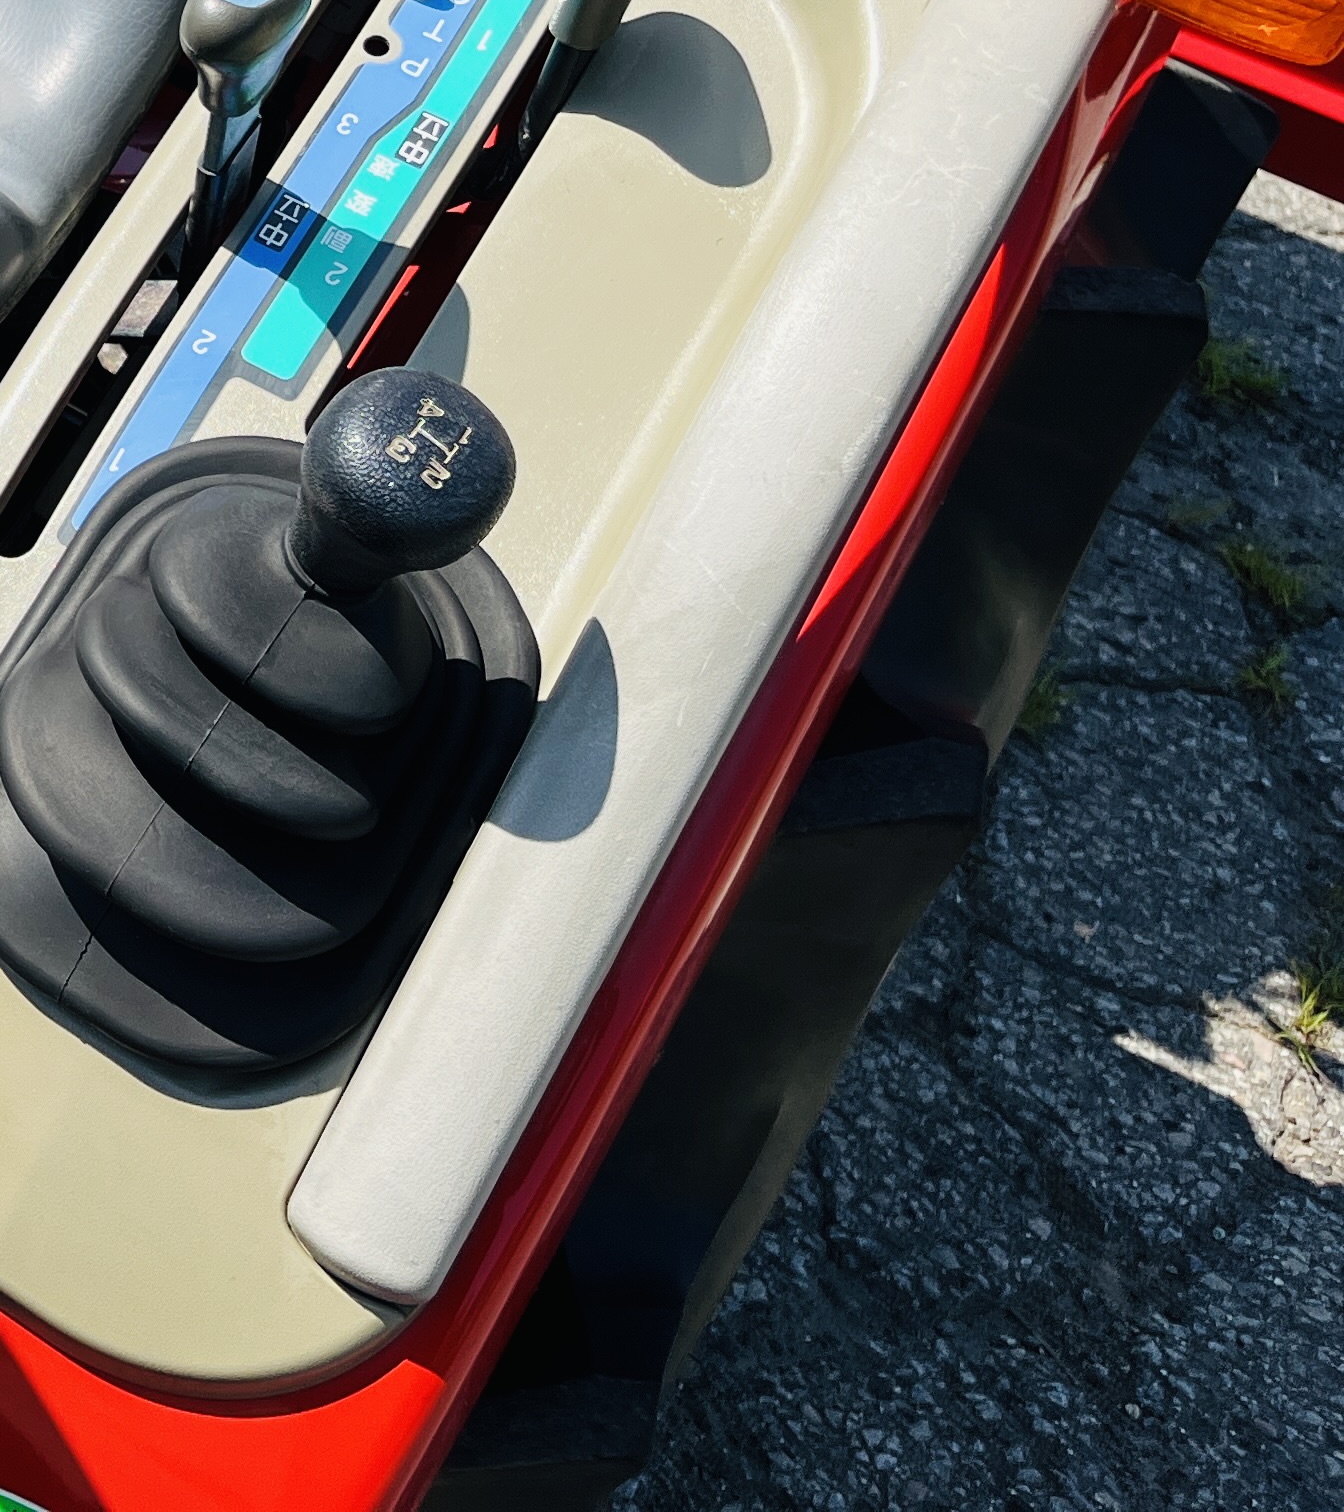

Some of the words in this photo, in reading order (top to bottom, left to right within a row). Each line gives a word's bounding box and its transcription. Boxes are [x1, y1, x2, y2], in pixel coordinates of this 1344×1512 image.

[336, 113, 359, 134] 3
[399, 112, 449, 165] 中立
[259, 193, 311, 246] 中立
[325, 262, 348, 285] 2
[192, 329, 217, 355] 2
[417, 398, 445, 419] 4
[109, 448, 124, 472] 1
[385, 435, 416, 463] 3
[420, 459, 451, 489] 2
